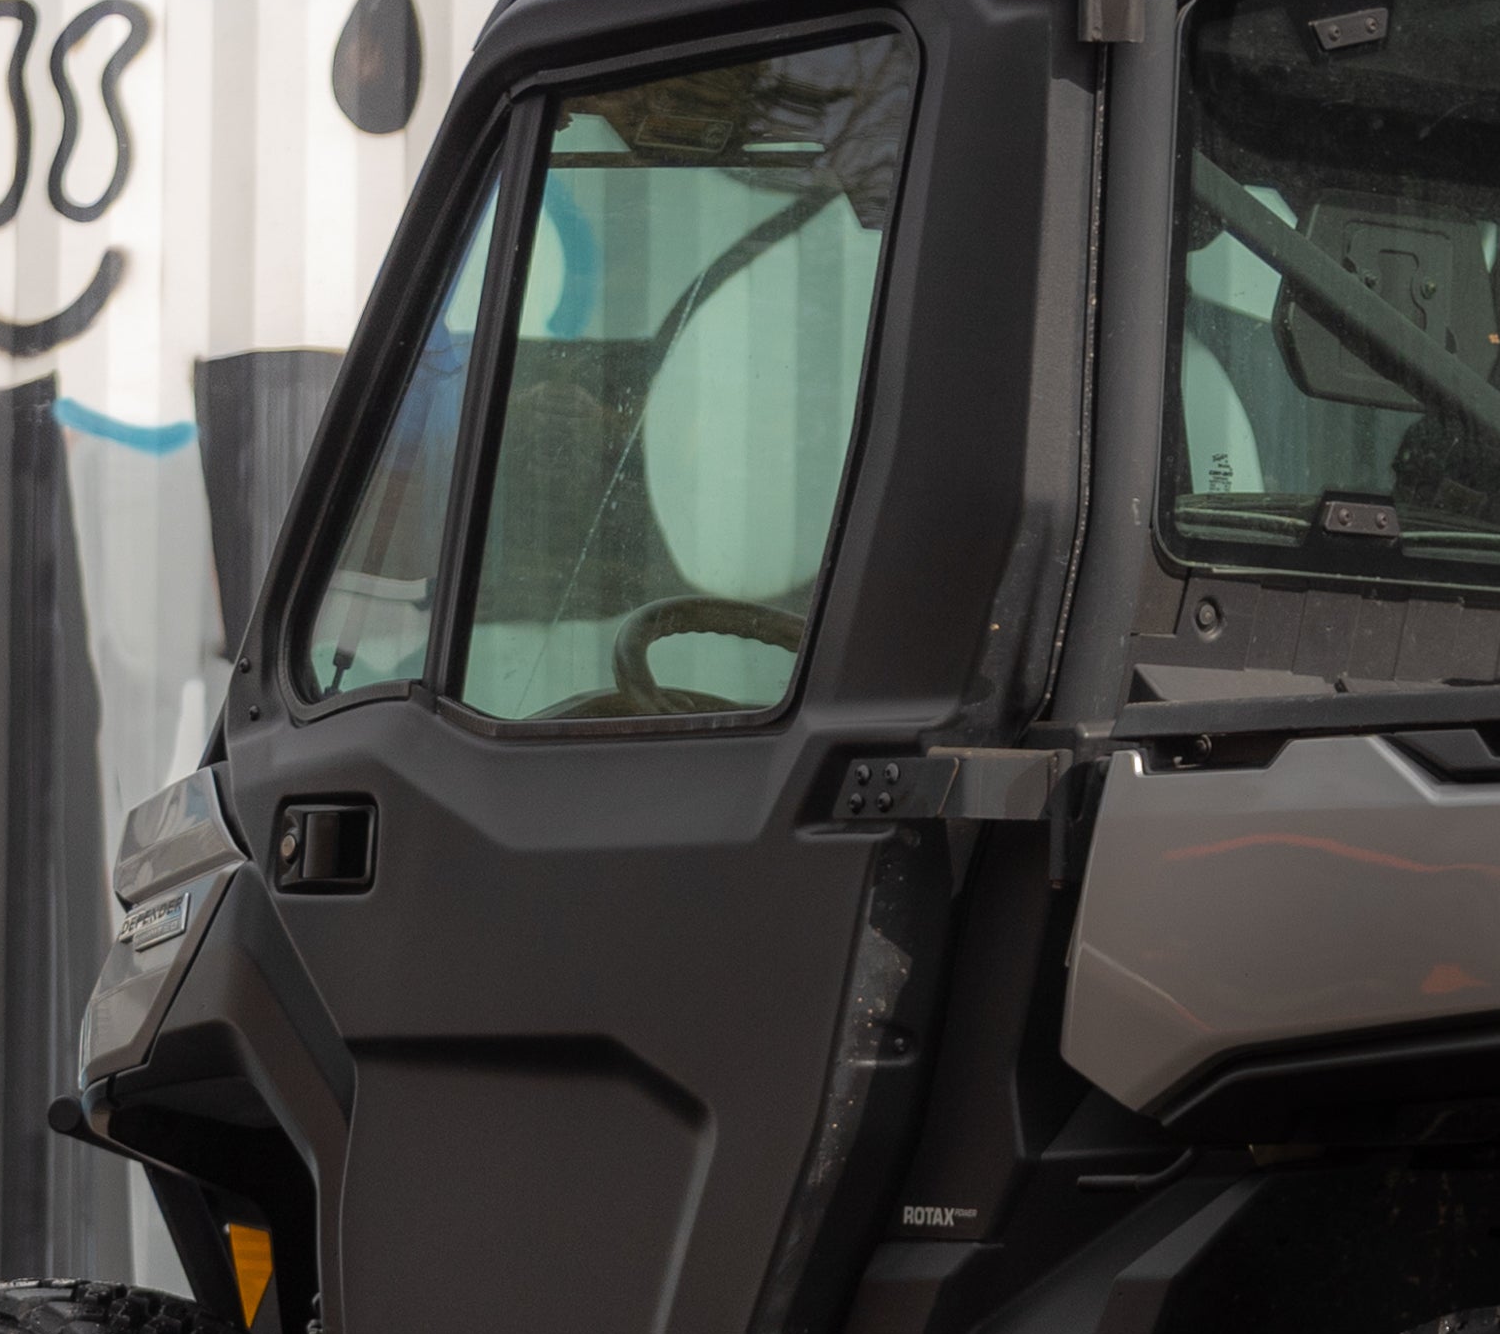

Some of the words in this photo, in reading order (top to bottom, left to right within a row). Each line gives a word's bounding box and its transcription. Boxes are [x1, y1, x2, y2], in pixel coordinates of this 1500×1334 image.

[120, 896, 183, 935] DEFENDER
[902, 1205, 955, 1226] ROTAX
[954, 1208, 978, 1217] POWER
